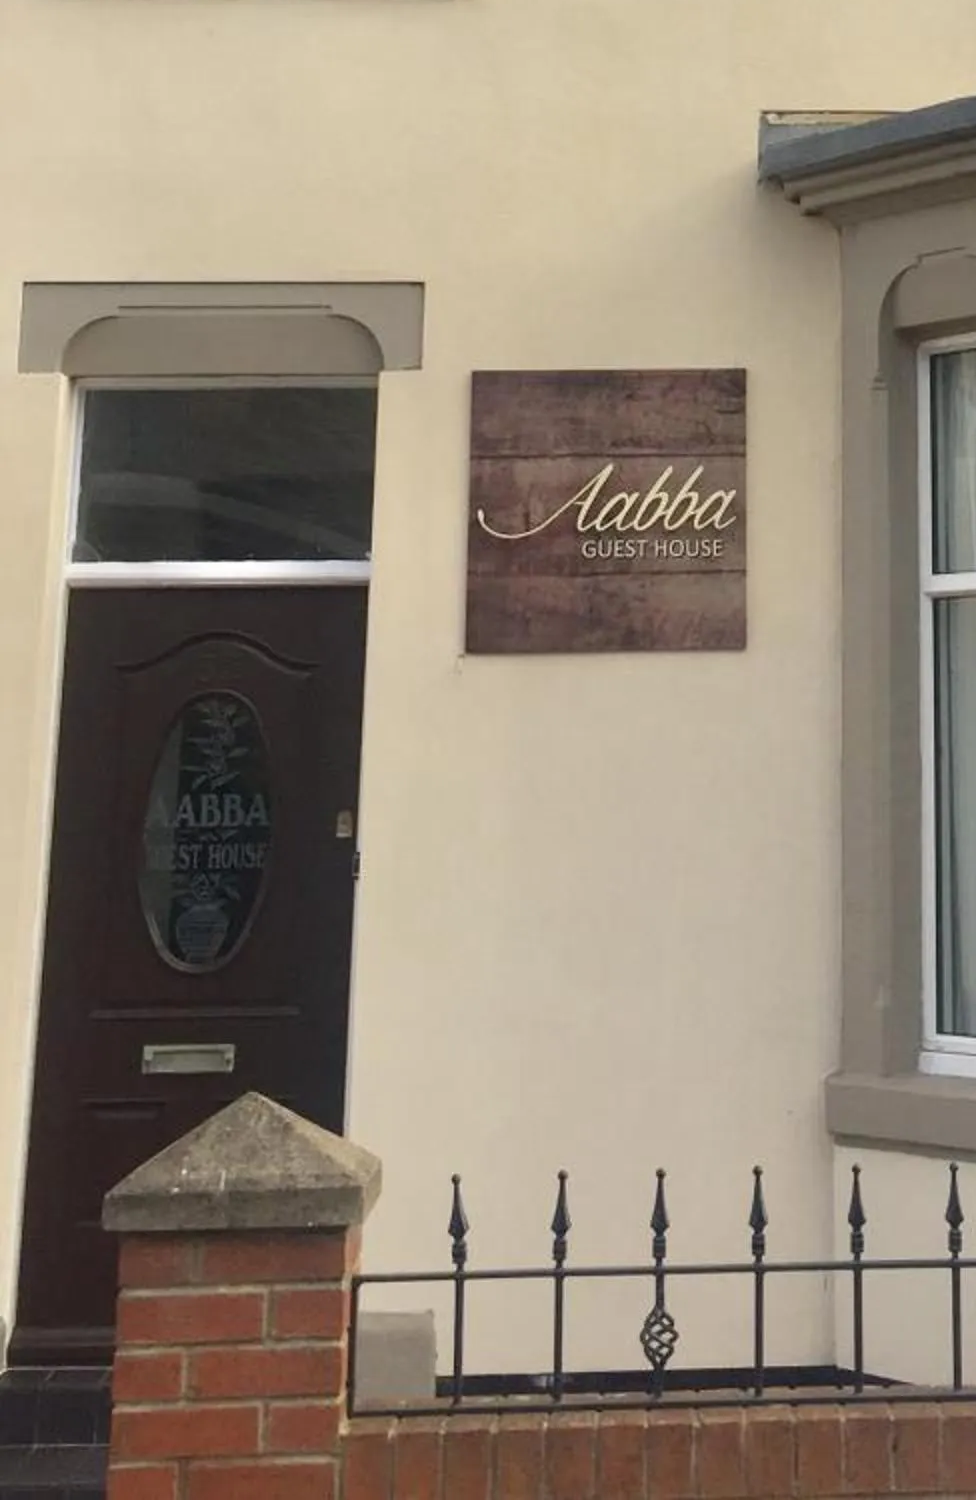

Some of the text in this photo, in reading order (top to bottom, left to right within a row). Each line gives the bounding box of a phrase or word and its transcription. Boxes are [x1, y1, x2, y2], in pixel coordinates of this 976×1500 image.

[476, 462, 737, 539] Aabba
[581, 538, 724, 559] GUEST HOUSE
